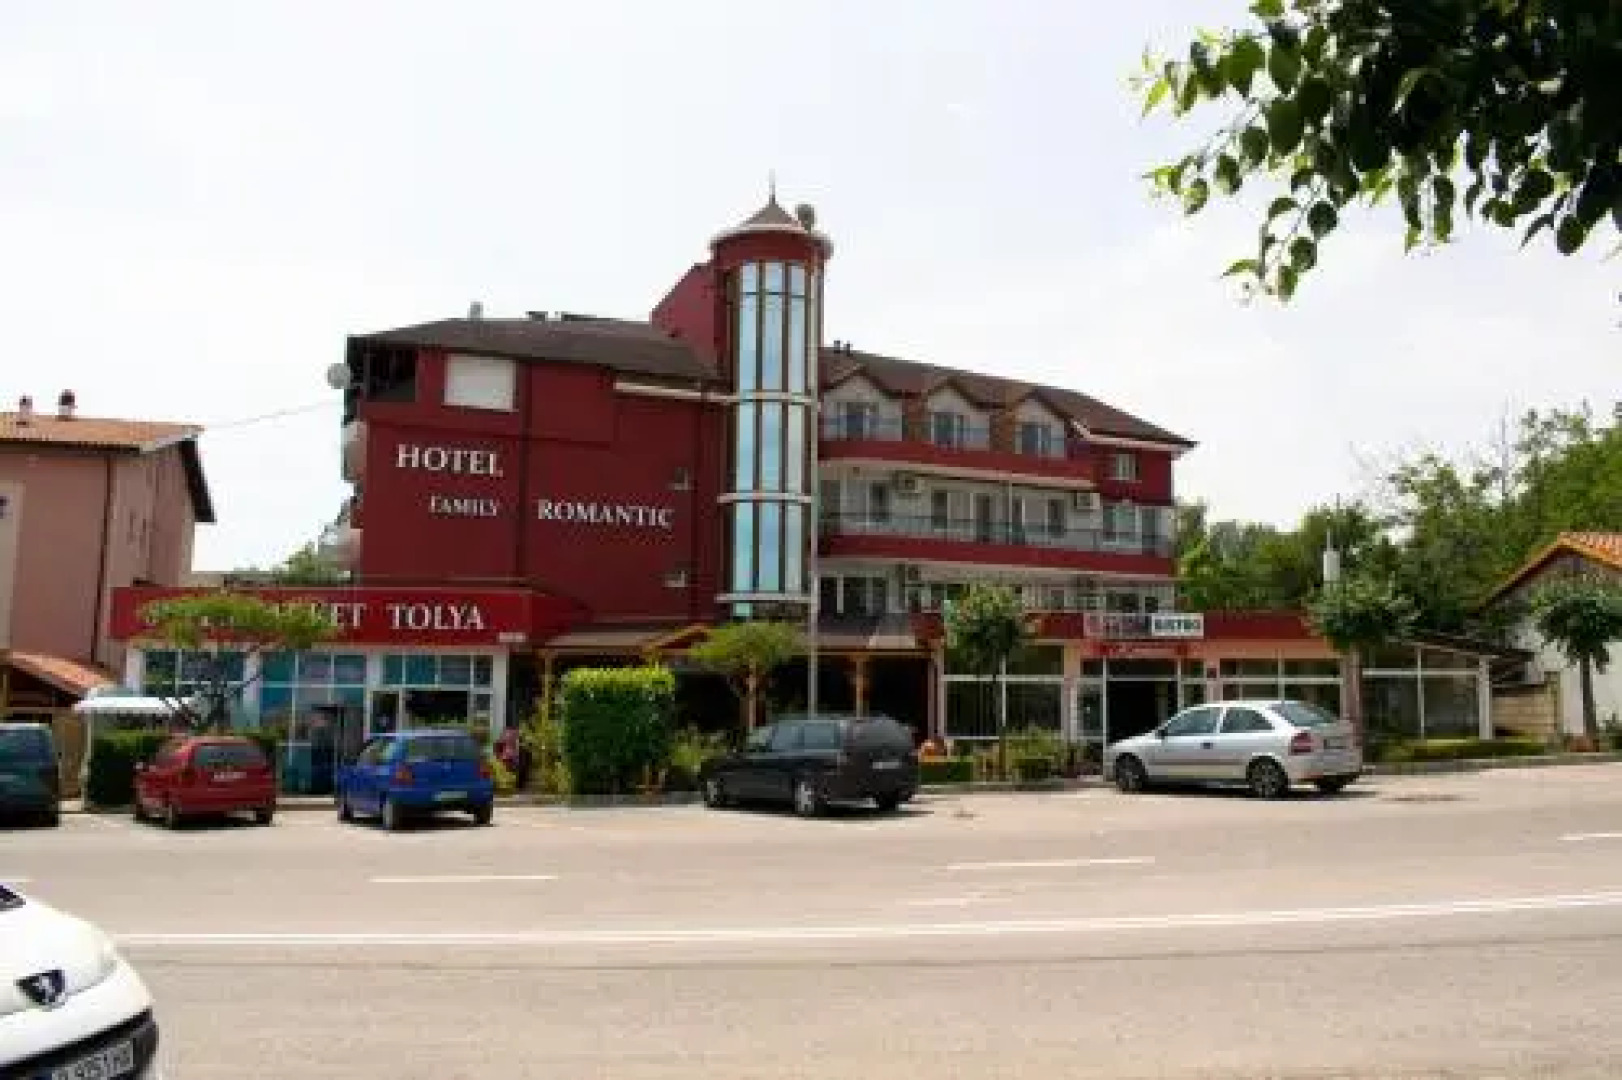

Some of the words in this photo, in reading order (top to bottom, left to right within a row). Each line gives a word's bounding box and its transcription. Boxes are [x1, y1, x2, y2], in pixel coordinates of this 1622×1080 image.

[396, 444, 503, 477] HOTEL
[429, 494, 498, 517] FAMILY
[537, 499, 674, 527] ROMANTIC
[387, 603, 485, 630] TOLYA
